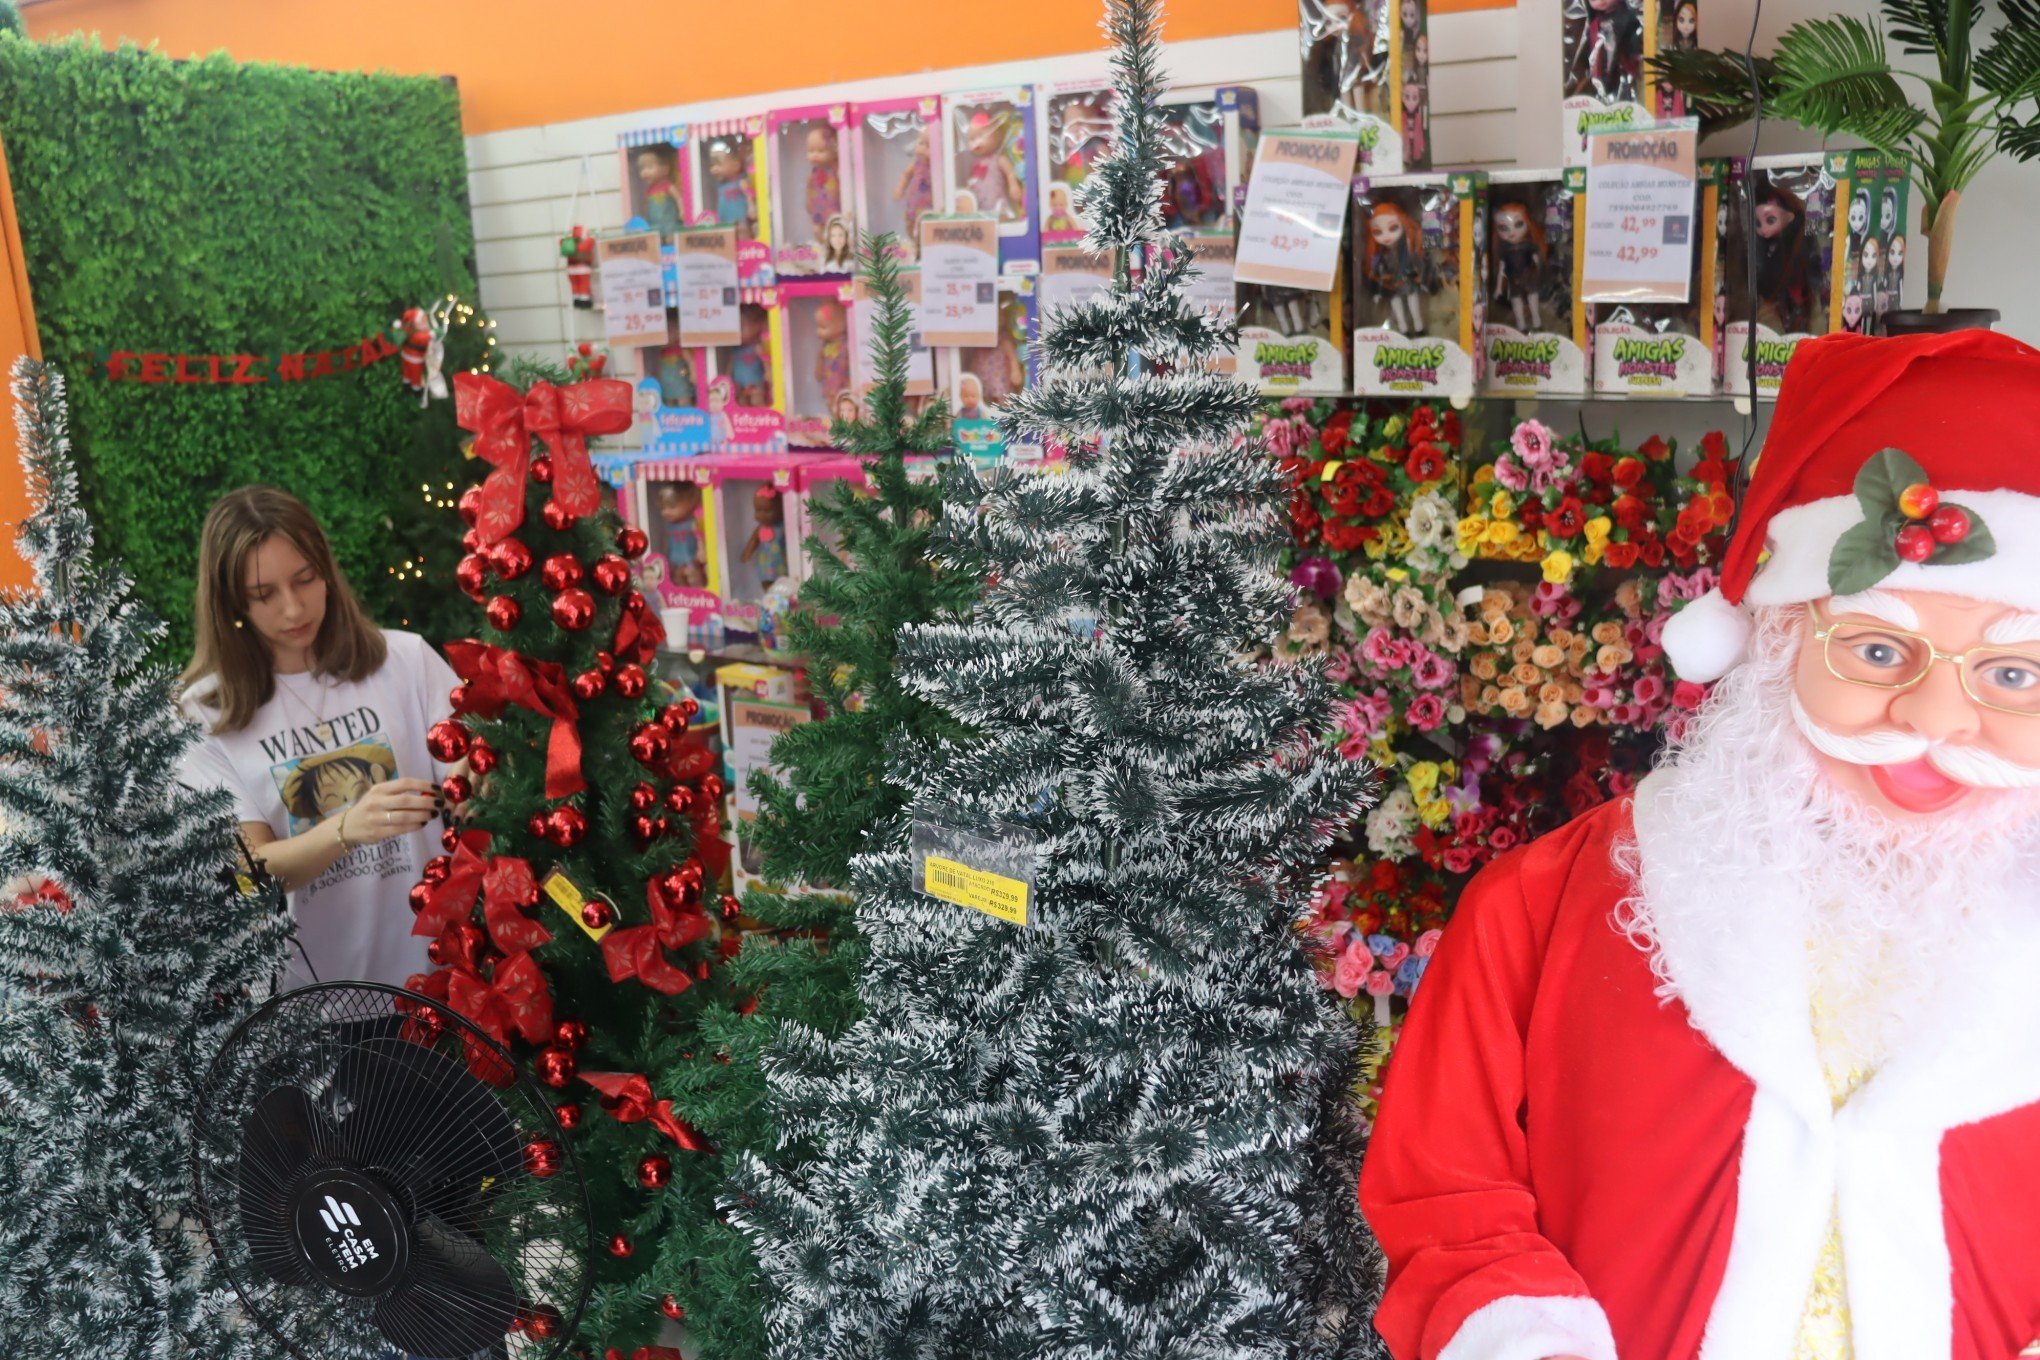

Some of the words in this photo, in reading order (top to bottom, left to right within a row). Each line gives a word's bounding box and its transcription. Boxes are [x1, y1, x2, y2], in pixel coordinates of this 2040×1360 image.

[1275, 139, 1341, 164] PROMOÇÃO
[1607, 137, 1678, 162] PROMOÇÃO
[1620, 215, 1656, 234] 42,99
[1270, 234, 1309, 252] 42,99
[1616, 246, 1659, 264] 42,99
[106, 351, 267, 384] FELIZ
[279, 332, 399, 382] NATAL
[1254, 341, 1319, 364] AMIGAS
[1373, 344, 1446, 369] AMIGAS
[1491, 338, 1559, 362] AMIGAS
[1613, 336, 1685, 363] AMIGAS
[1379, 368, 1439, 386] MONSTER
[1495, 362, 1552, 379] MONSTER
[1618, 361, 1677, 380] MONSTER
[259, 705, 381, 763] WANTED
[325, 1236, 348, 1273] ELETRO
[338, 1239, 359, 1269] TEM
[344, 1228, 368, 1265] CASA
[362, 1238, 380, 1259] EM
